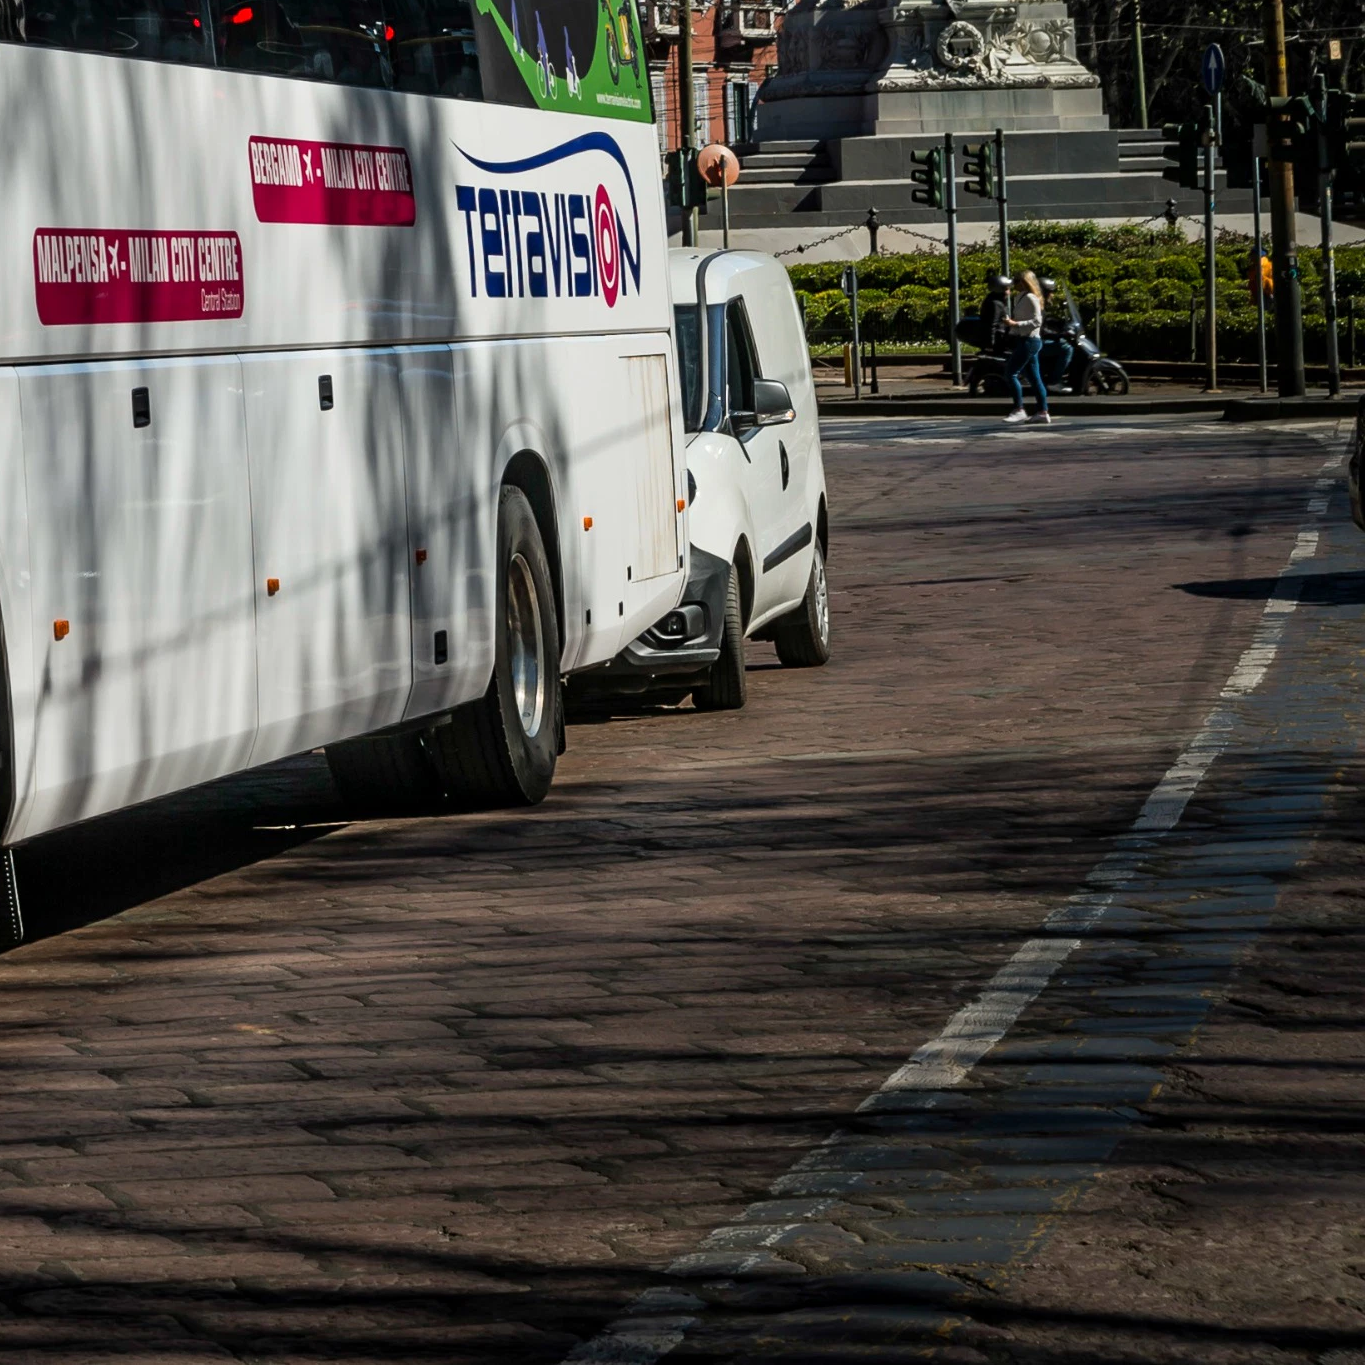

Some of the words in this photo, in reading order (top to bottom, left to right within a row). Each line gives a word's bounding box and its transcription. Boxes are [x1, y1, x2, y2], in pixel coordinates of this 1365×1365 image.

[250, 141, 303, 187] BERGAMO
[321, 147, 356, 190] MILAN
[354, 150, 375, 191] CITY
[375, 151, 411, 192] CENTRE
[36, 235, 109, 283] MALPENSA
[128, 237, 170, 283] MILAN
[171, 237, 195, 283] CITY
[197, 237, 240, 282] CENTRE
[201, 288, 220, 312] Central
[221, 287, 242, 312] Station
